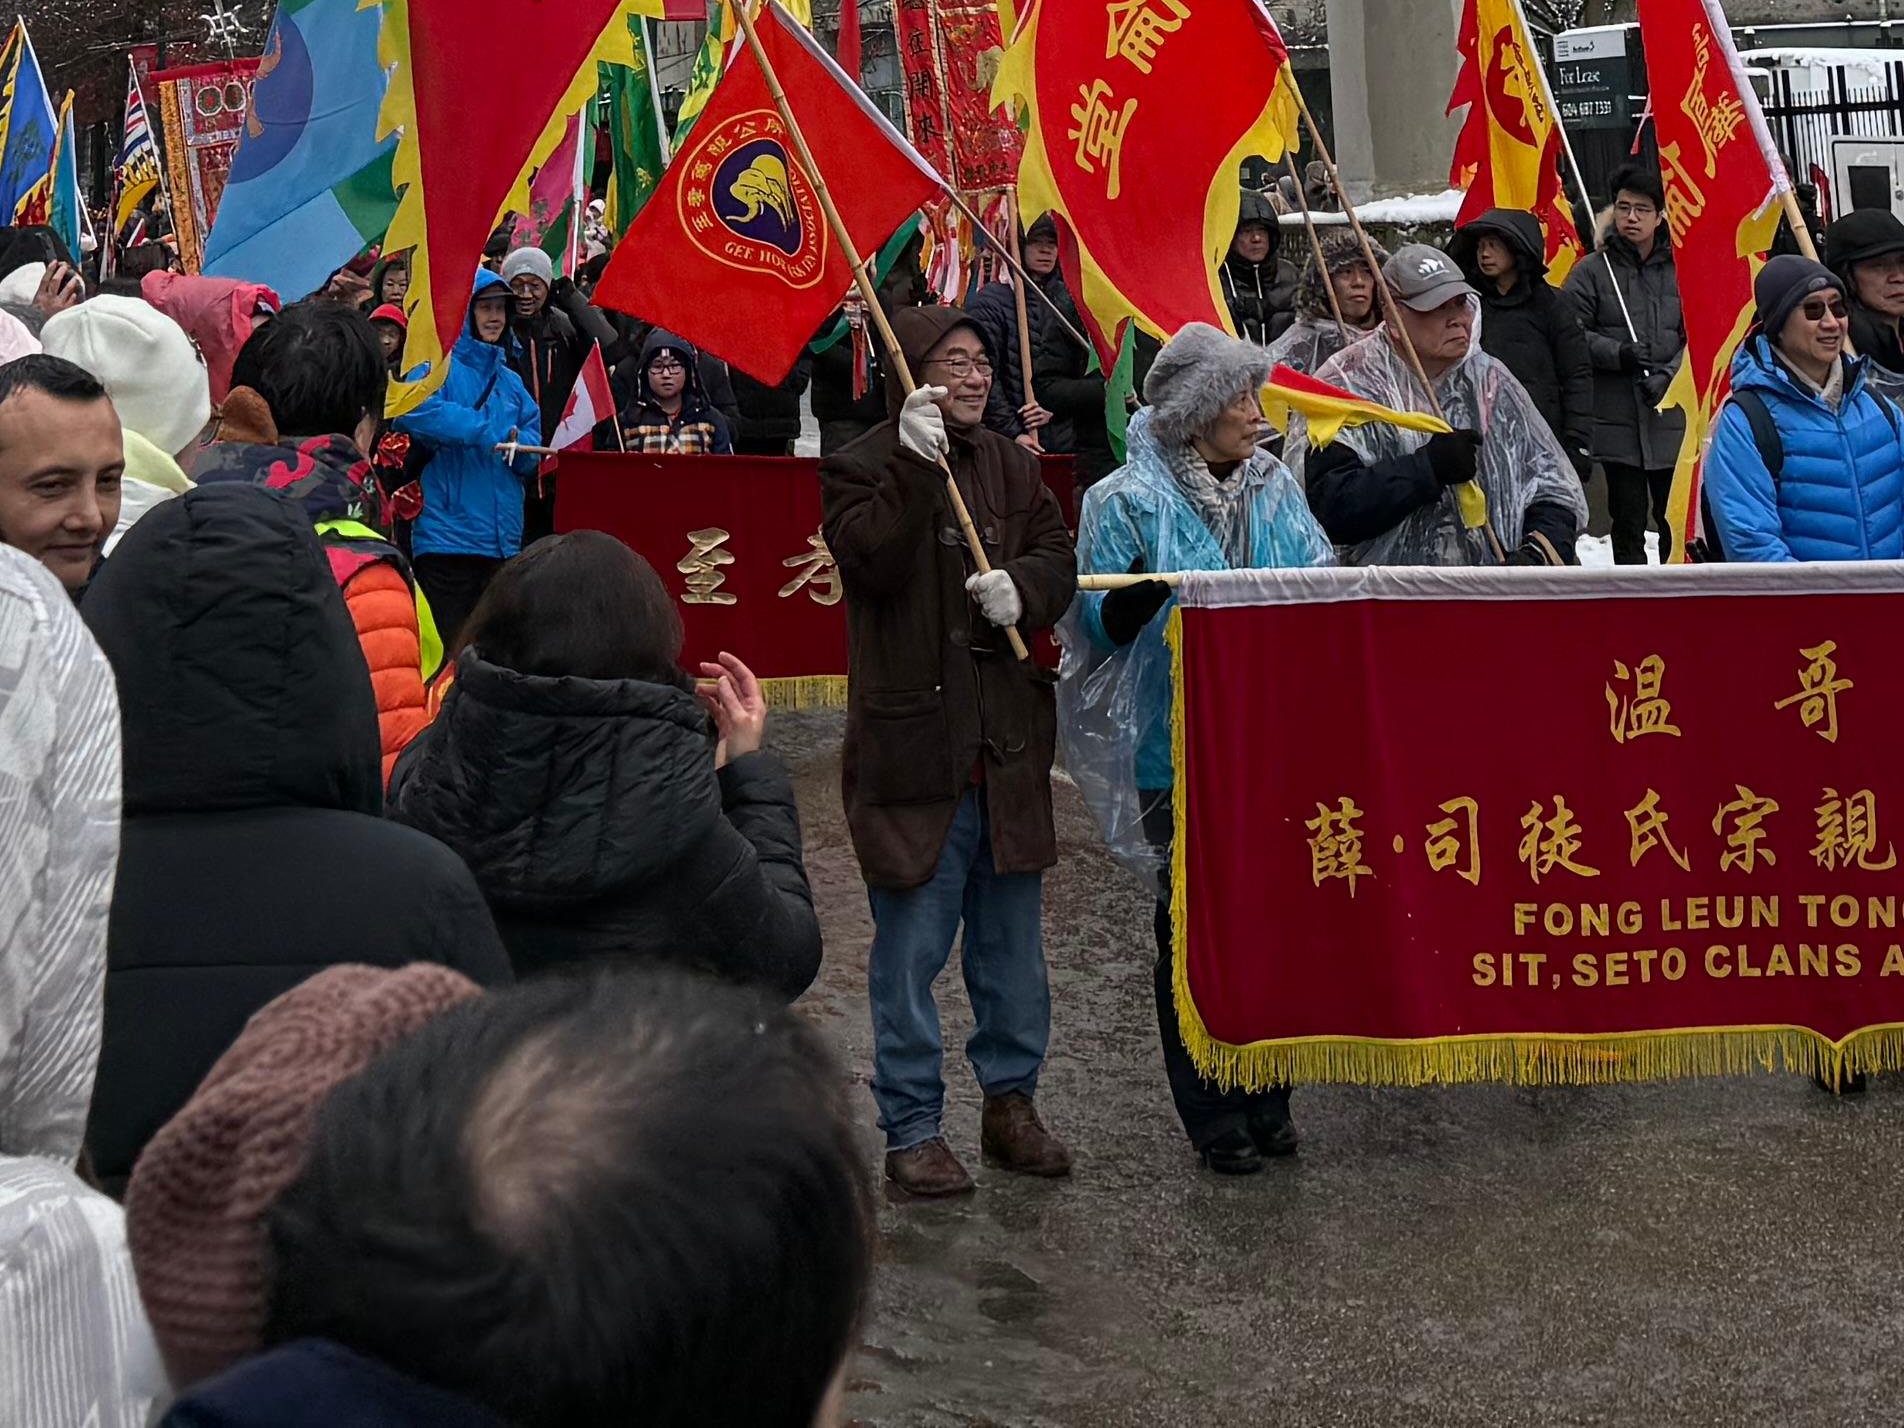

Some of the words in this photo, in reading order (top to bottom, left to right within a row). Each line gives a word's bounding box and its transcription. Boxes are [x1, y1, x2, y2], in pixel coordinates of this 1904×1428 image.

[1513, 900, 1643, 937] FONG
[1661, 894, 1781, 932] LEUN
[1704, 942, 1863, 980] CLANS
